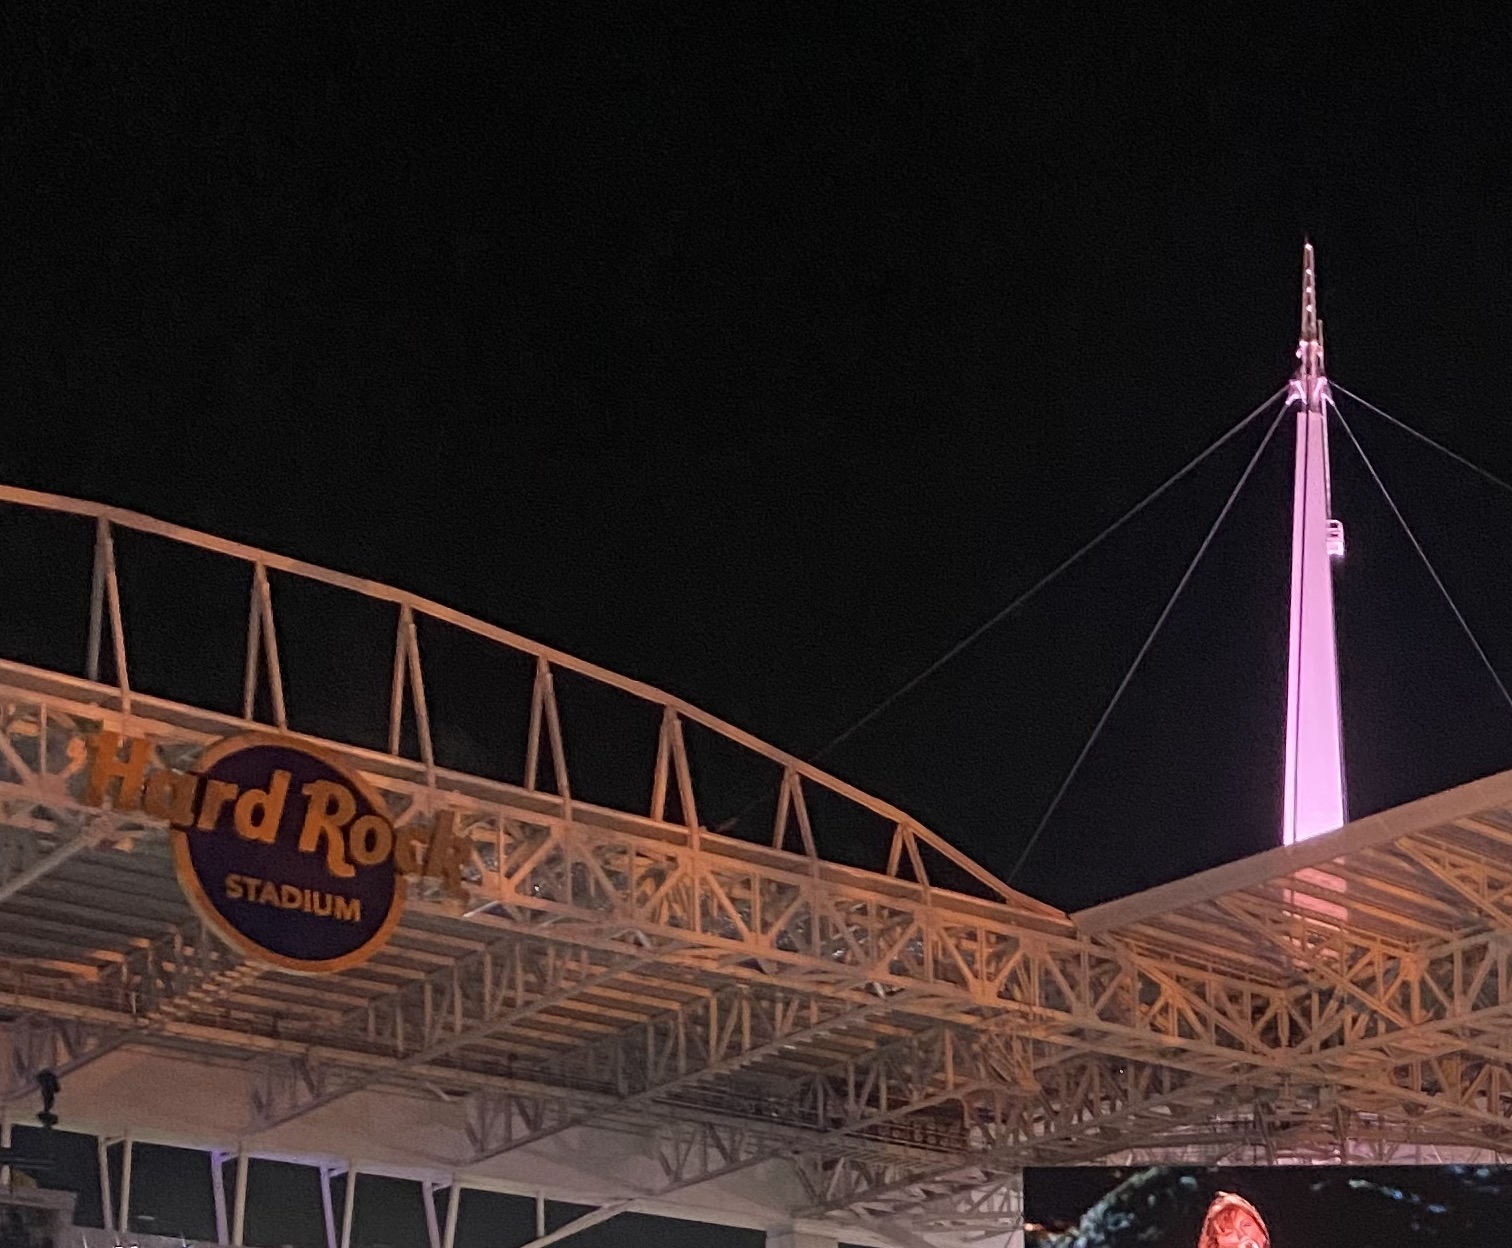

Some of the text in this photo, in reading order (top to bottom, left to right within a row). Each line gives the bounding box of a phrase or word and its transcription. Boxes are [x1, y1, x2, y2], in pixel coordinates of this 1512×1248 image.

[87, 729, 474, 906] Hard Rock
[225, 873, 361, 922] STADIUM
